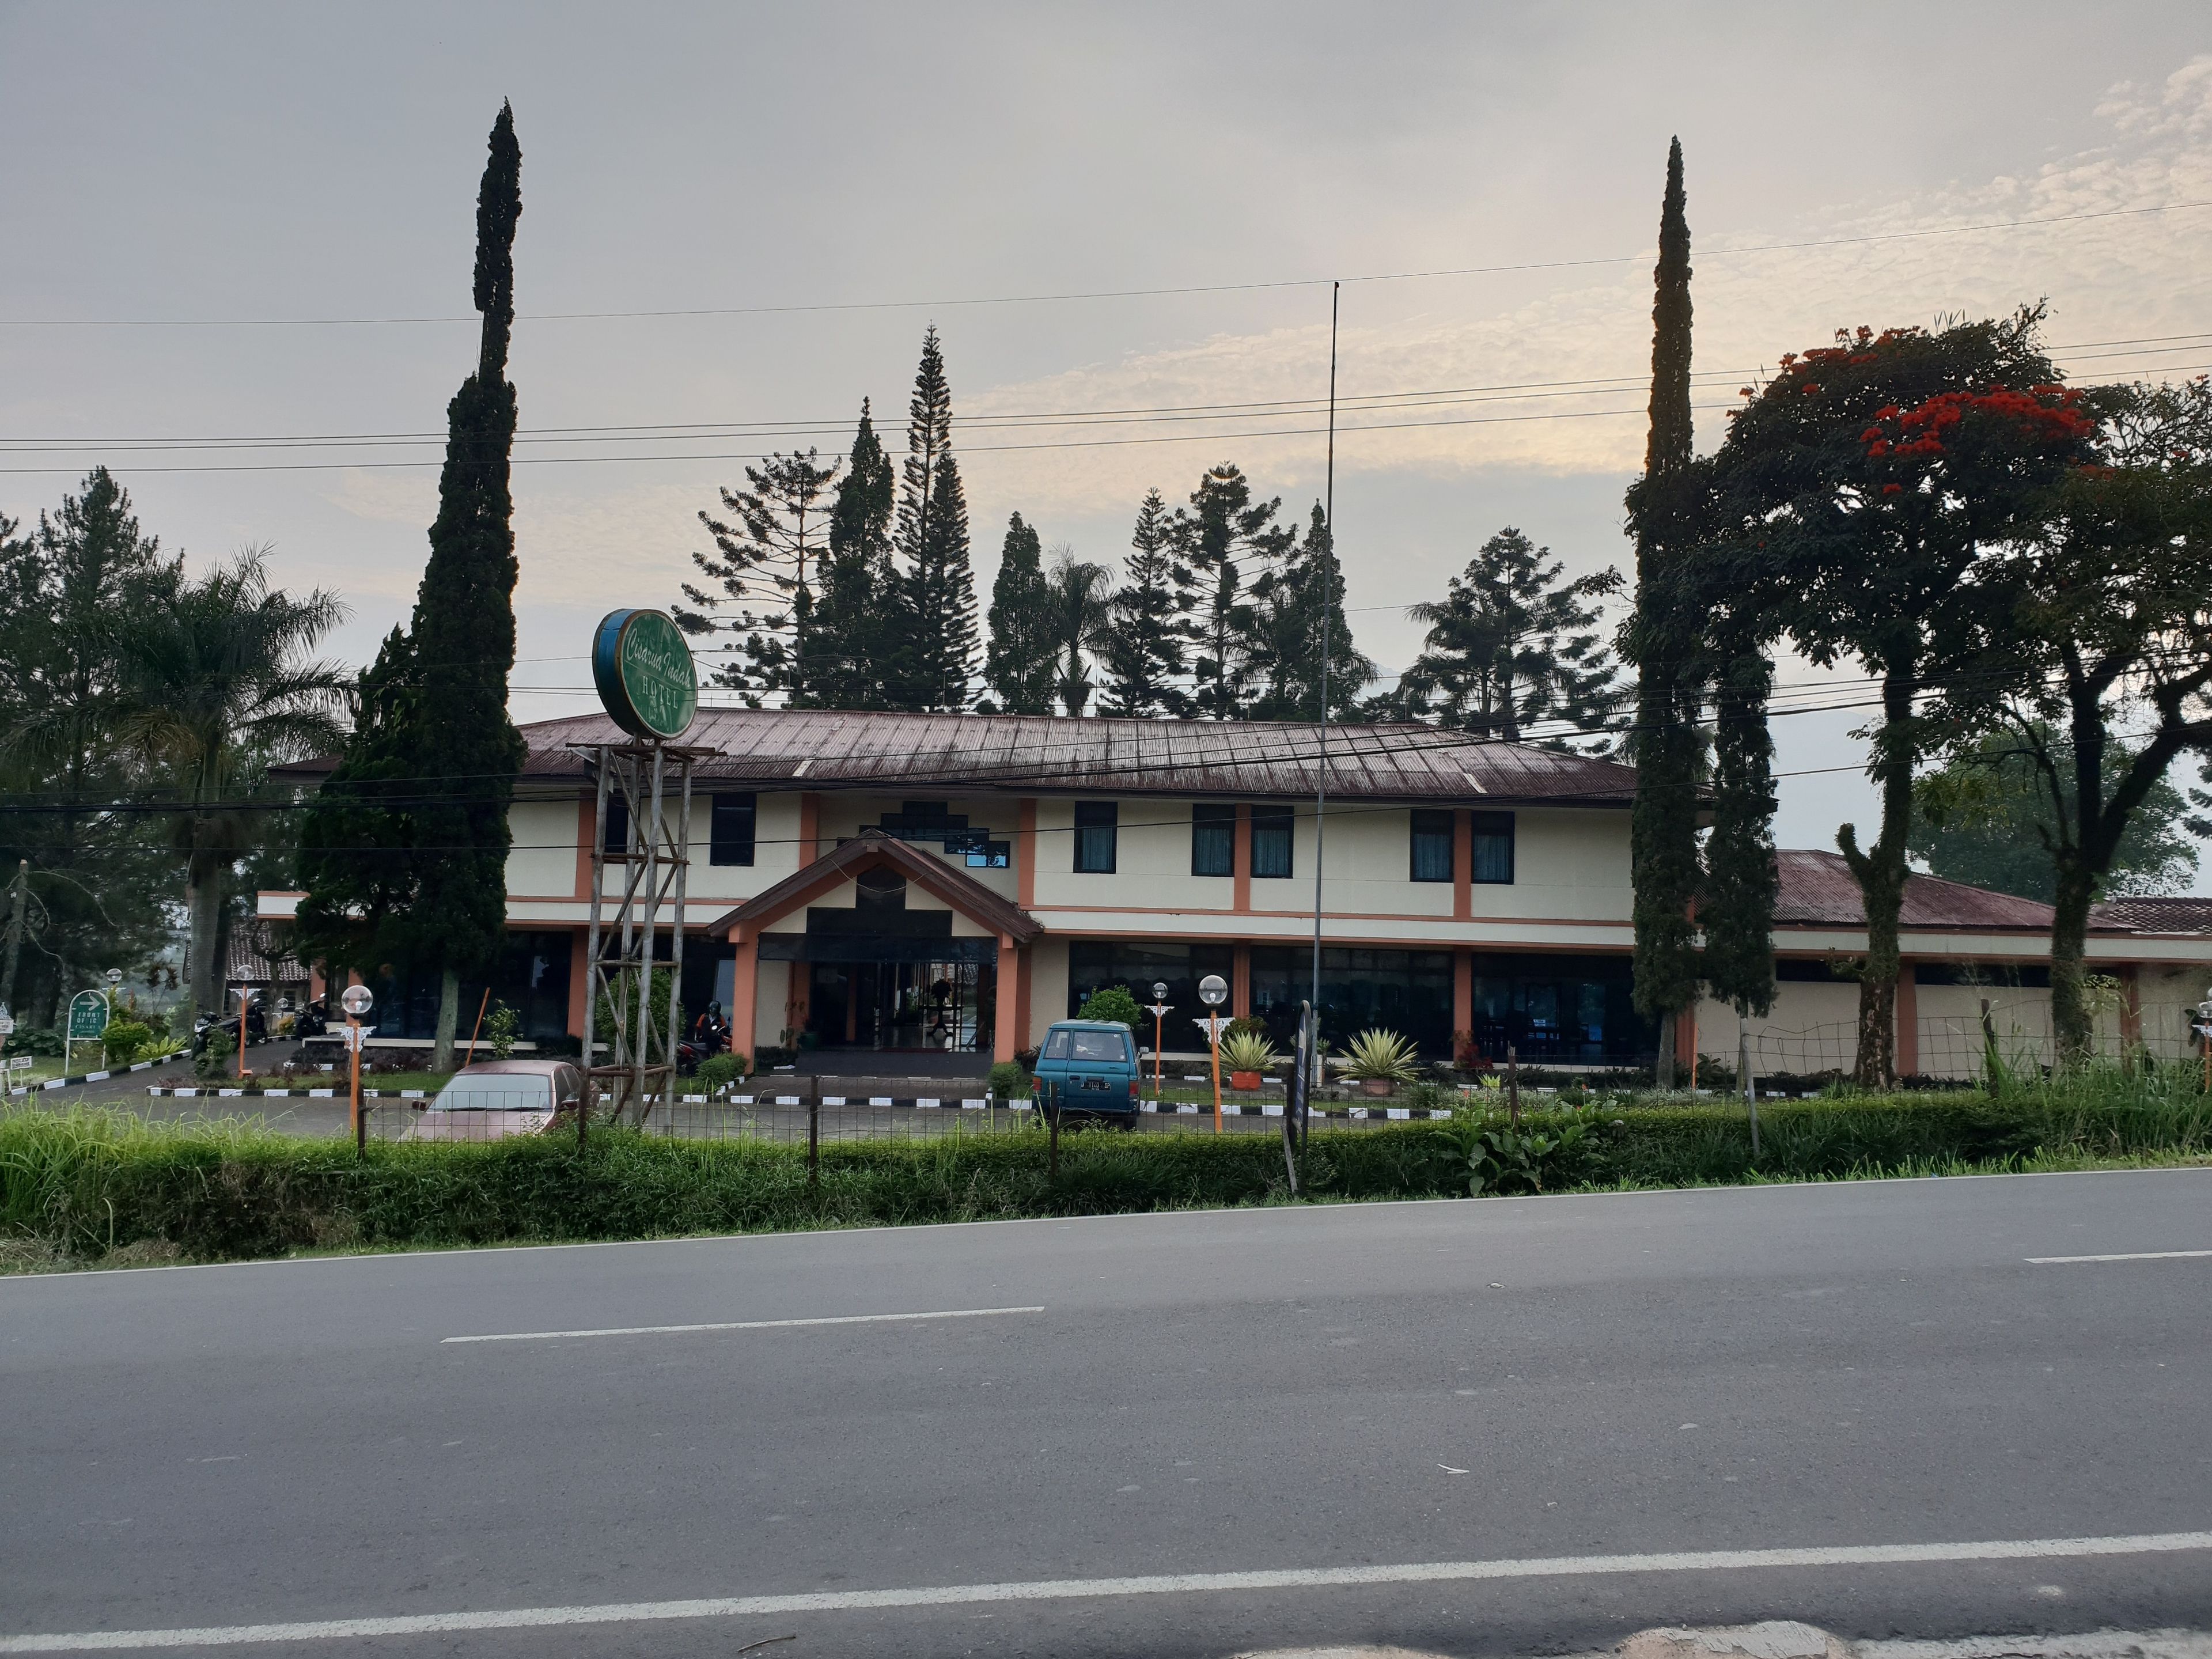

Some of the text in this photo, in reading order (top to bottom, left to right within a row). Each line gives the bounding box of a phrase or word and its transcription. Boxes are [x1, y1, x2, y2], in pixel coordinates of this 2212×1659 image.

[627, 628, 691, 688] Cisarua Indah
[642, 676, 678, 709] HOTEL
